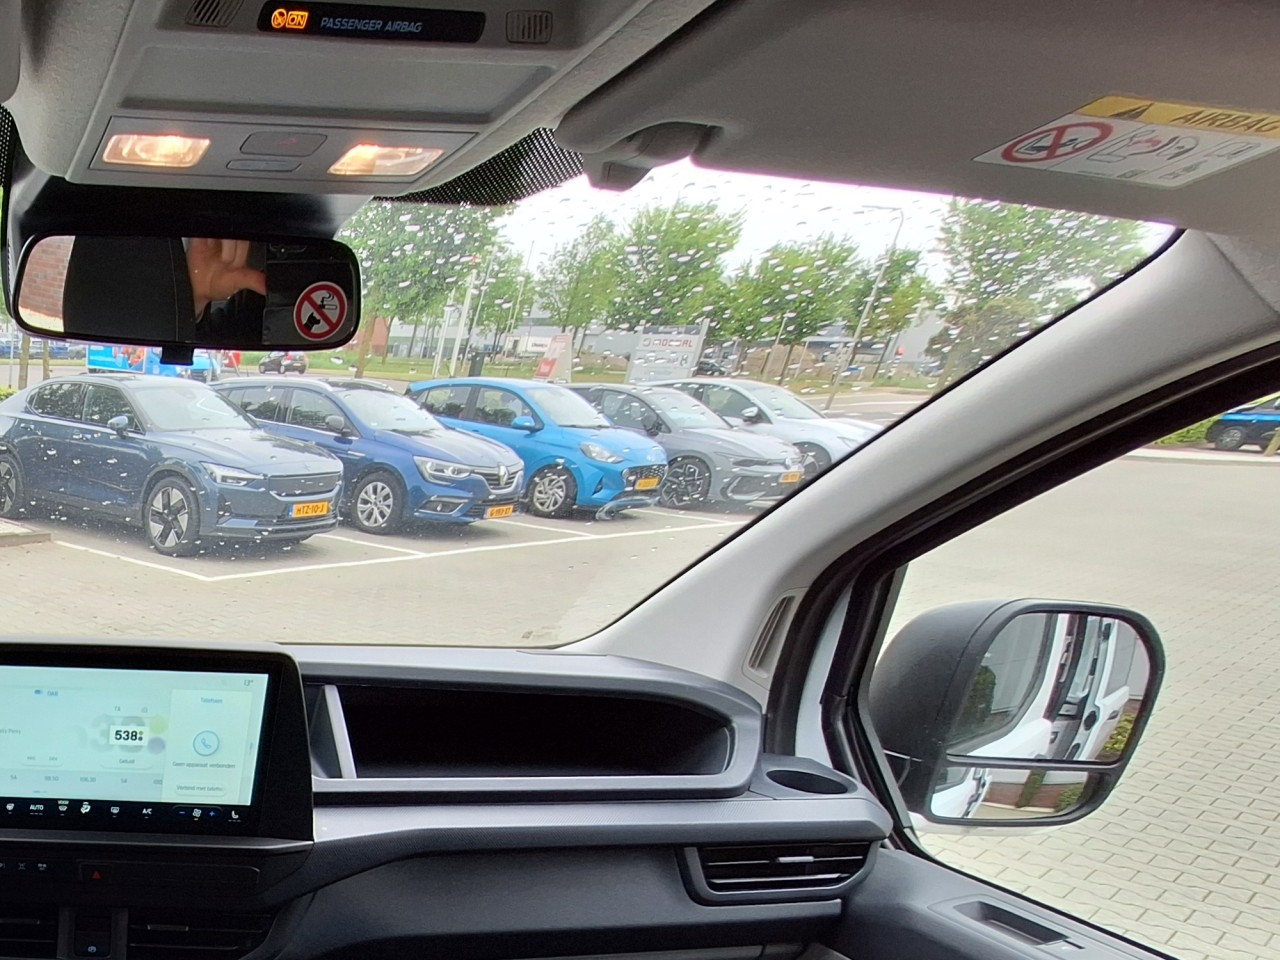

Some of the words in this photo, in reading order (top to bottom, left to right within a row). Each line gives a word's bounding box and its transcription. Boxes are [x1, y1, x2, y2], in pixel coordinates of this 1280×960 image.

[288, 15, 305, 26] ON
[320, 17, 383, 30] PASSENGER
[384, 20, 422, 33] AIRBAG
[114, 730, 138, 742] 538
